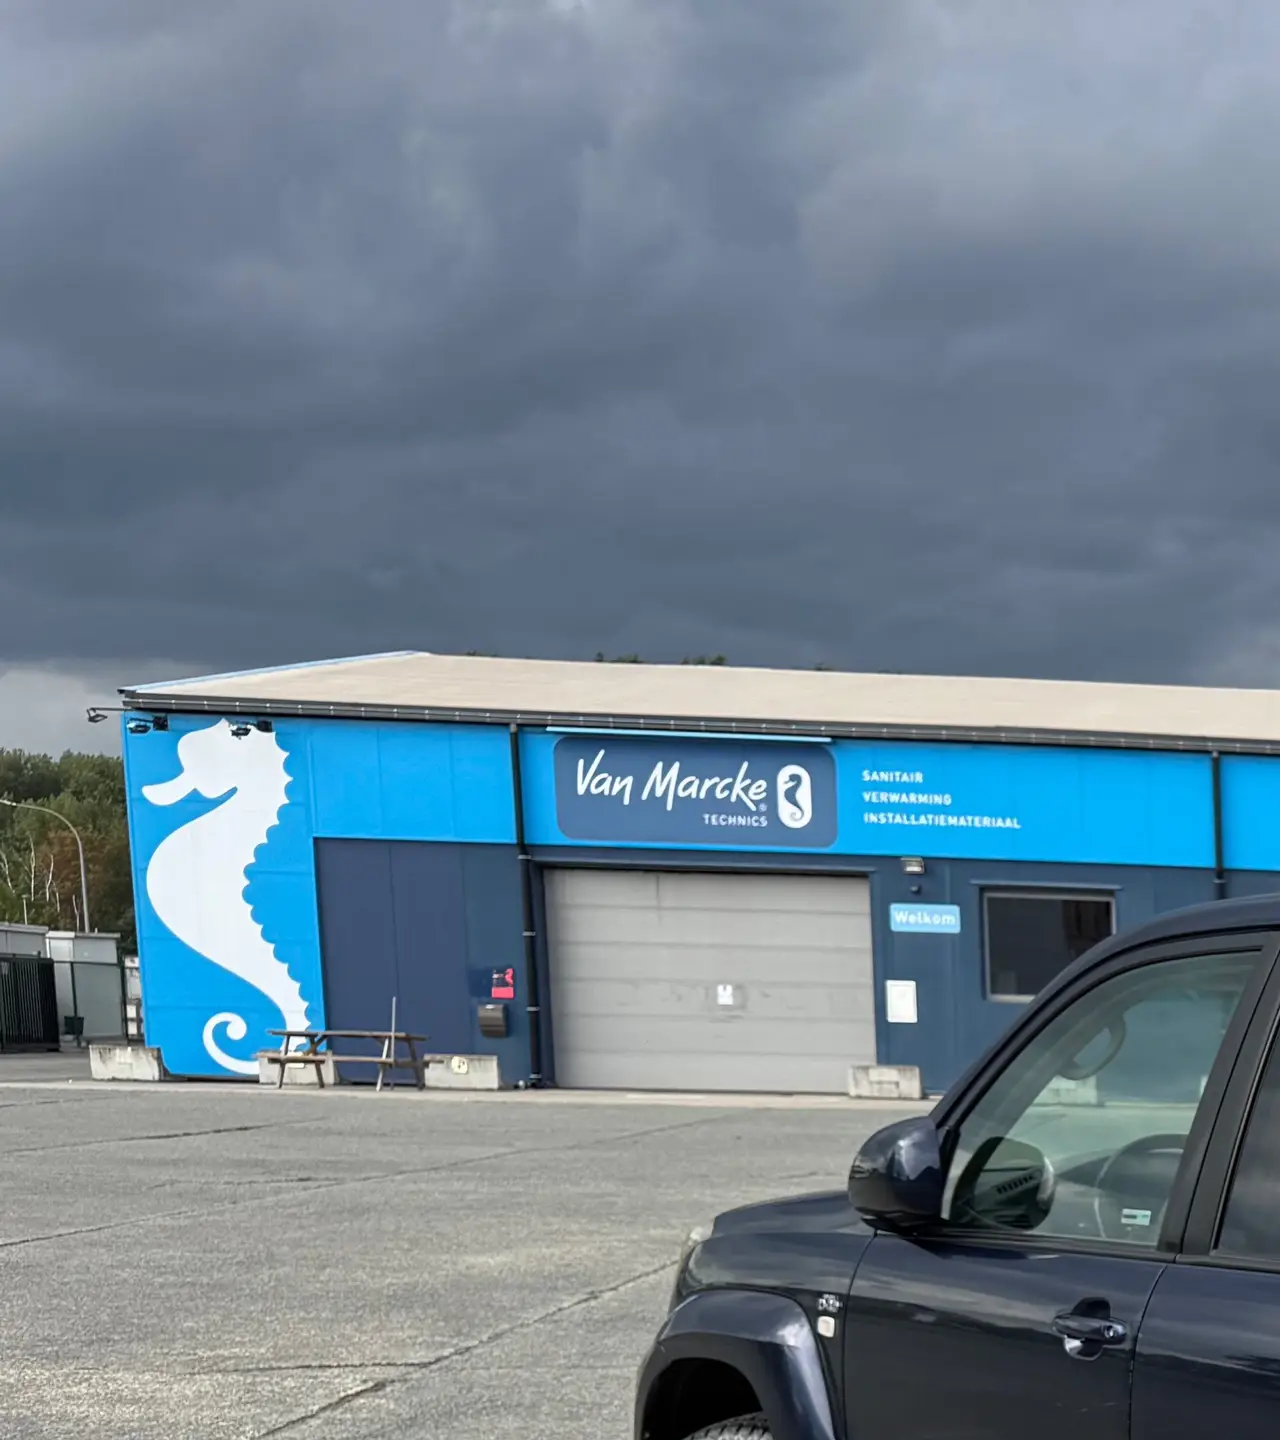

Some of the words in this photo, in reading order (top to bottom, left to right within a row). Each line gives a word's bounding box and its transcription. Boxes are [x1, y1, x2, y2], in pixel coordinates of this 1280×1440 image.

[576, 749, 634, 805] Van
[641, 761, 767, 811] Marcke
[862, 770, 923, 783] SANITAIR
[862, 791, 952, 806] VERWARMING
[702, 813, 768, 827] TECHNICS
[863, 812, 1022, 829] INSTALLATIEMATERIAAL
[895, 910, 956, 925] Welkom
